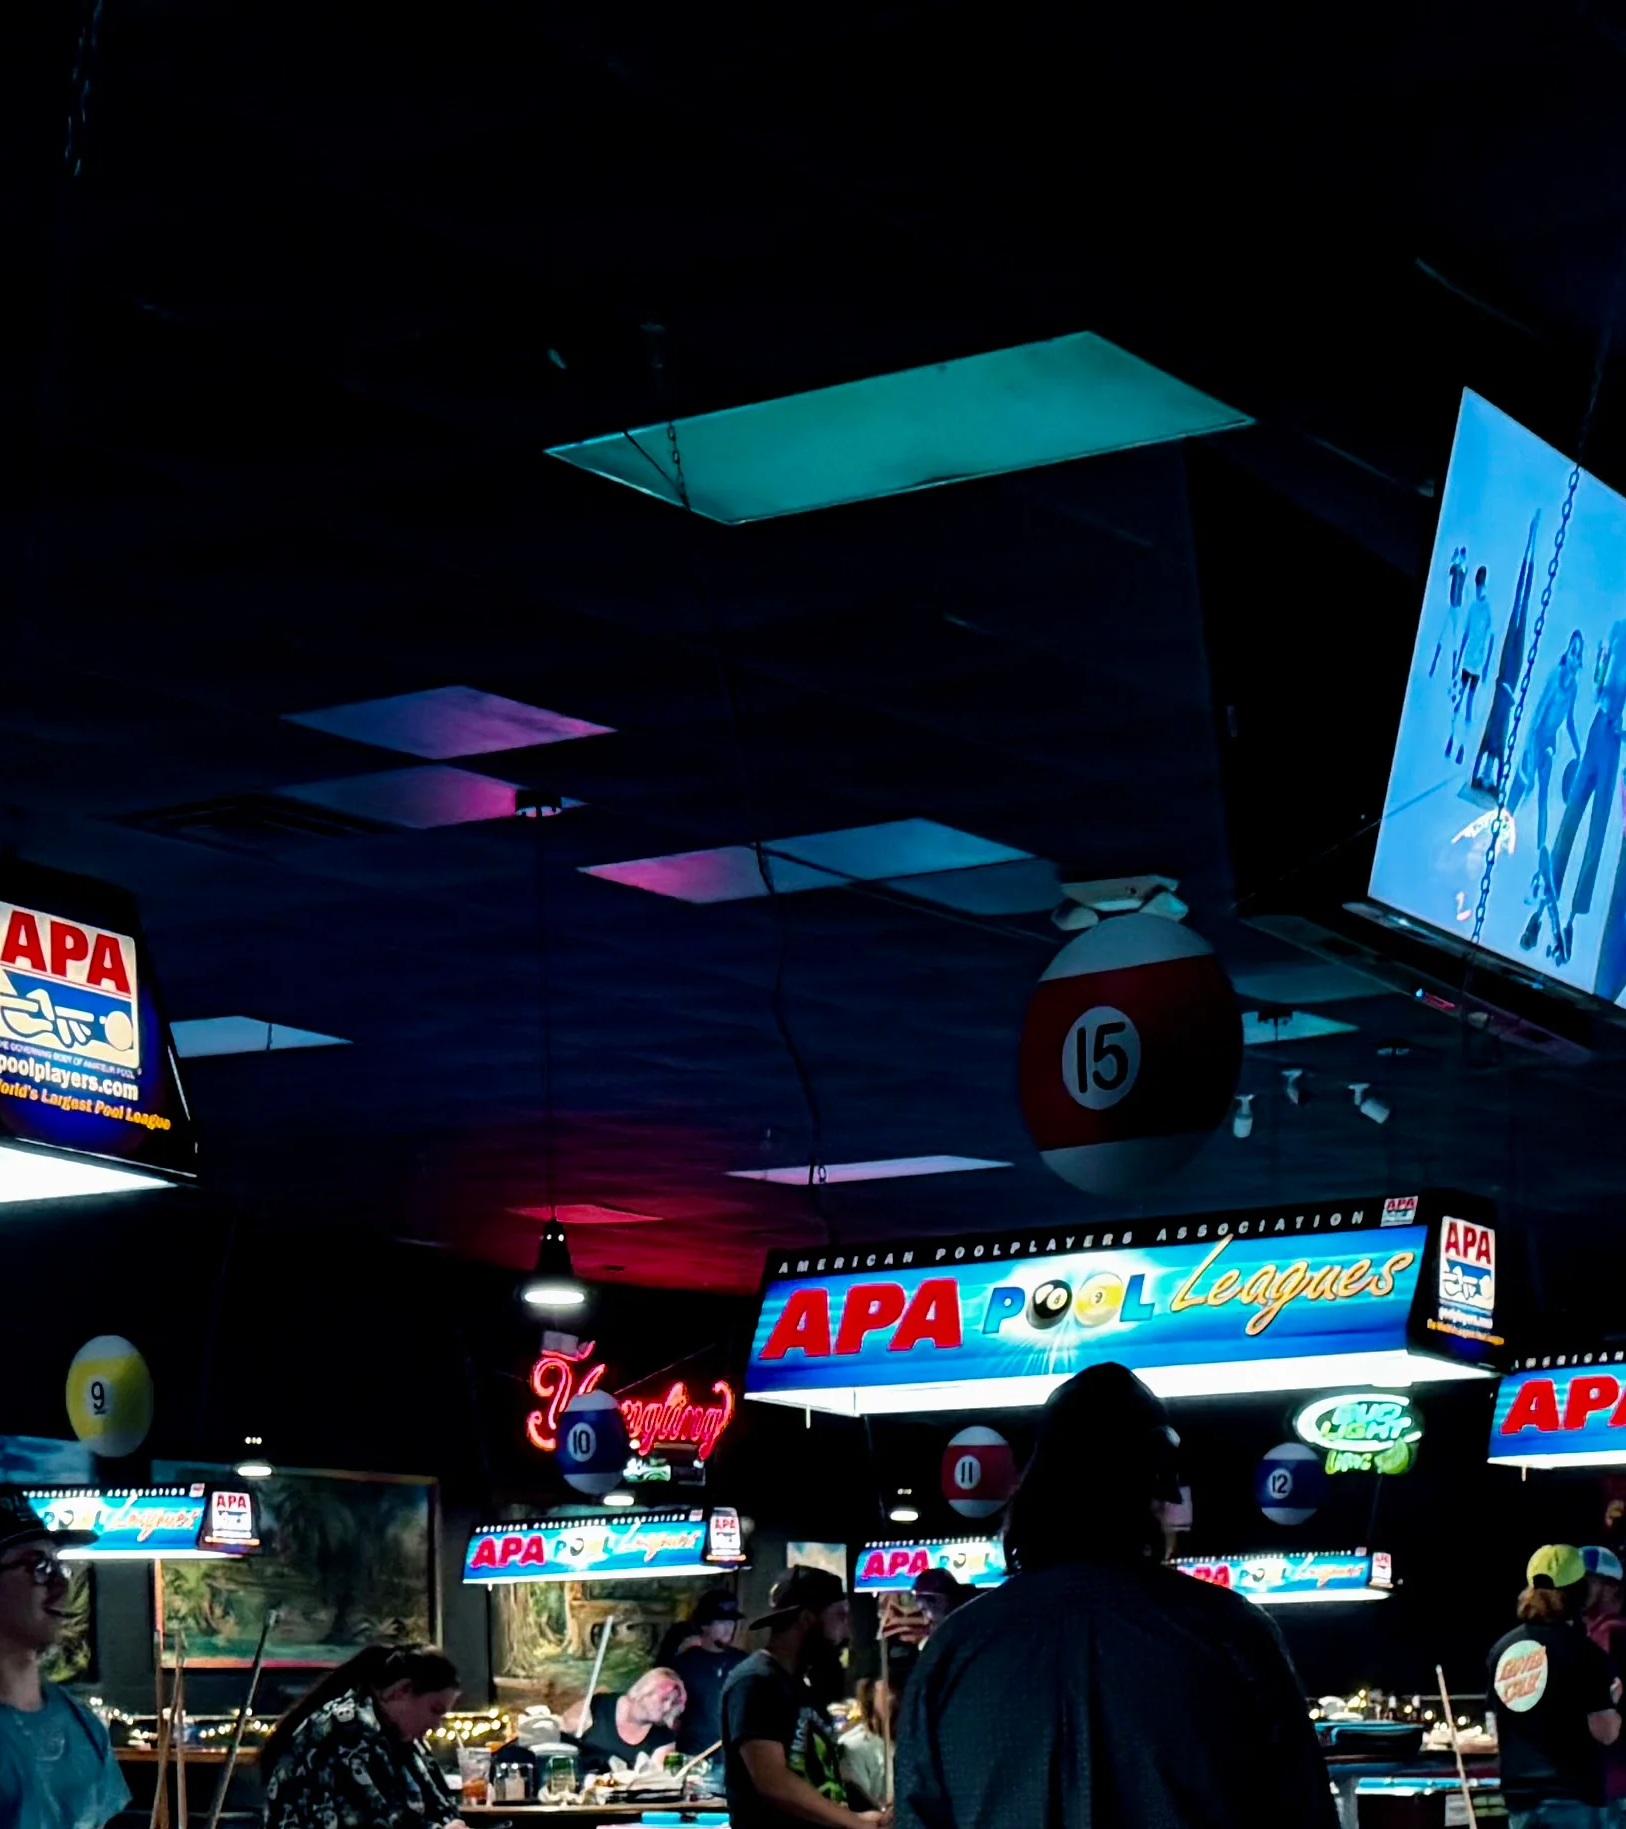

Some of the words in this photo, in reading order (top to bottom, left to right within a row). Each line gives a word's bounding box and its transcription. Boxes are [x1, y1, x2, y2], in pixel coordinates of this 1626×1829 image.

[0, 909, 132, 996] APA
[1076, 1021, 1129, 1094] 15
[40, 1088, 93, 1113] Largest
[94, 1101, 124, 1119] Pool
[125, 1107, 172, 1131] League
[778, 1250, 915, 1275] AMERICAN
[935, 1230, 1134, 1262] POOLPLAYERS
[1156, 1210, 1365, 1243] ASSOCIATION
[1444, 1221, 1492, 1266] APA
[758, 1276, 964, 1361] APA
[981, 1271, 1156, 1335] POOL
[1170, 1233, 1415, 1336] Leagues
[572, 1429, 591, 1455] 10
[216, 1494, 247, 1510] APA
[1271, 1474, 1288, 1495] 12
[469, 1535, 547, 1568] APA
[861, 1549, 930, 1579] APA
